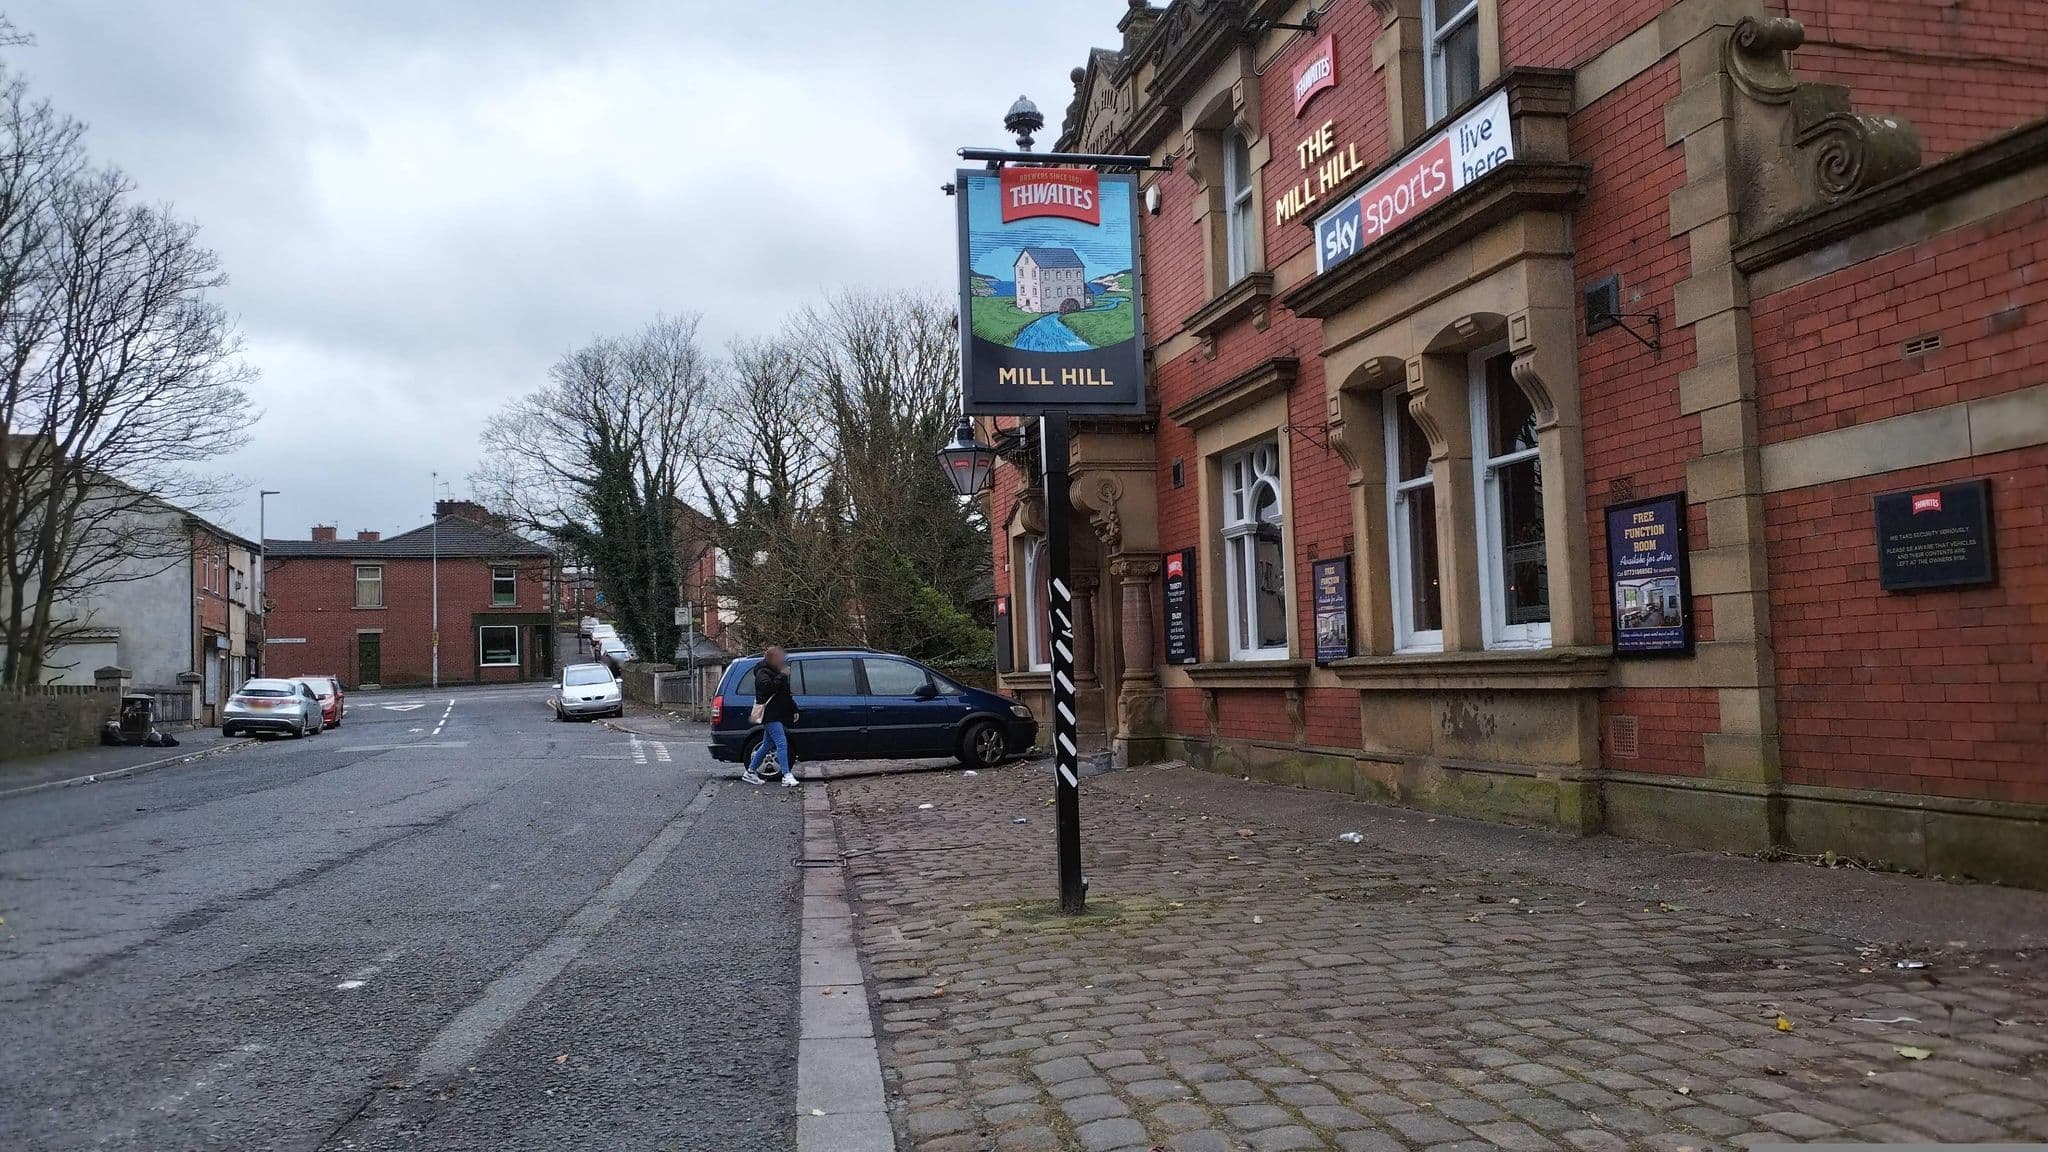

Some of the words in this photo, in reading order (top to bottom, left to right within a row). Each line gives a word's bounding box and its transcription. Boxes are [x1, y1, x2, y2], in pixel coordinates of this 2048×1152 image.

[1297, 120, 1335, 171] THE
[1460, 115, 1492, 156] live
[1050, 172, 1067, 181] SINCE
[1462, 144, 1507, 185] here
[1009, 182, 1093, 210] THWAITES
[1276, 178, 1316, 226] MILL
[1319, 142, 1364, 193] HILL
[1325, 212, 1359, 260] sky
[1366, 156, 1447, 237] sports
[999, 367, 1053, 385] MILL
[1062, 367, 1113, 386] HILL
[1624, 524, 1665, 539] FUNCTION
[1633, 511, 1654, 524] FREE
[1634, 539, 1656, 552] ROOM
